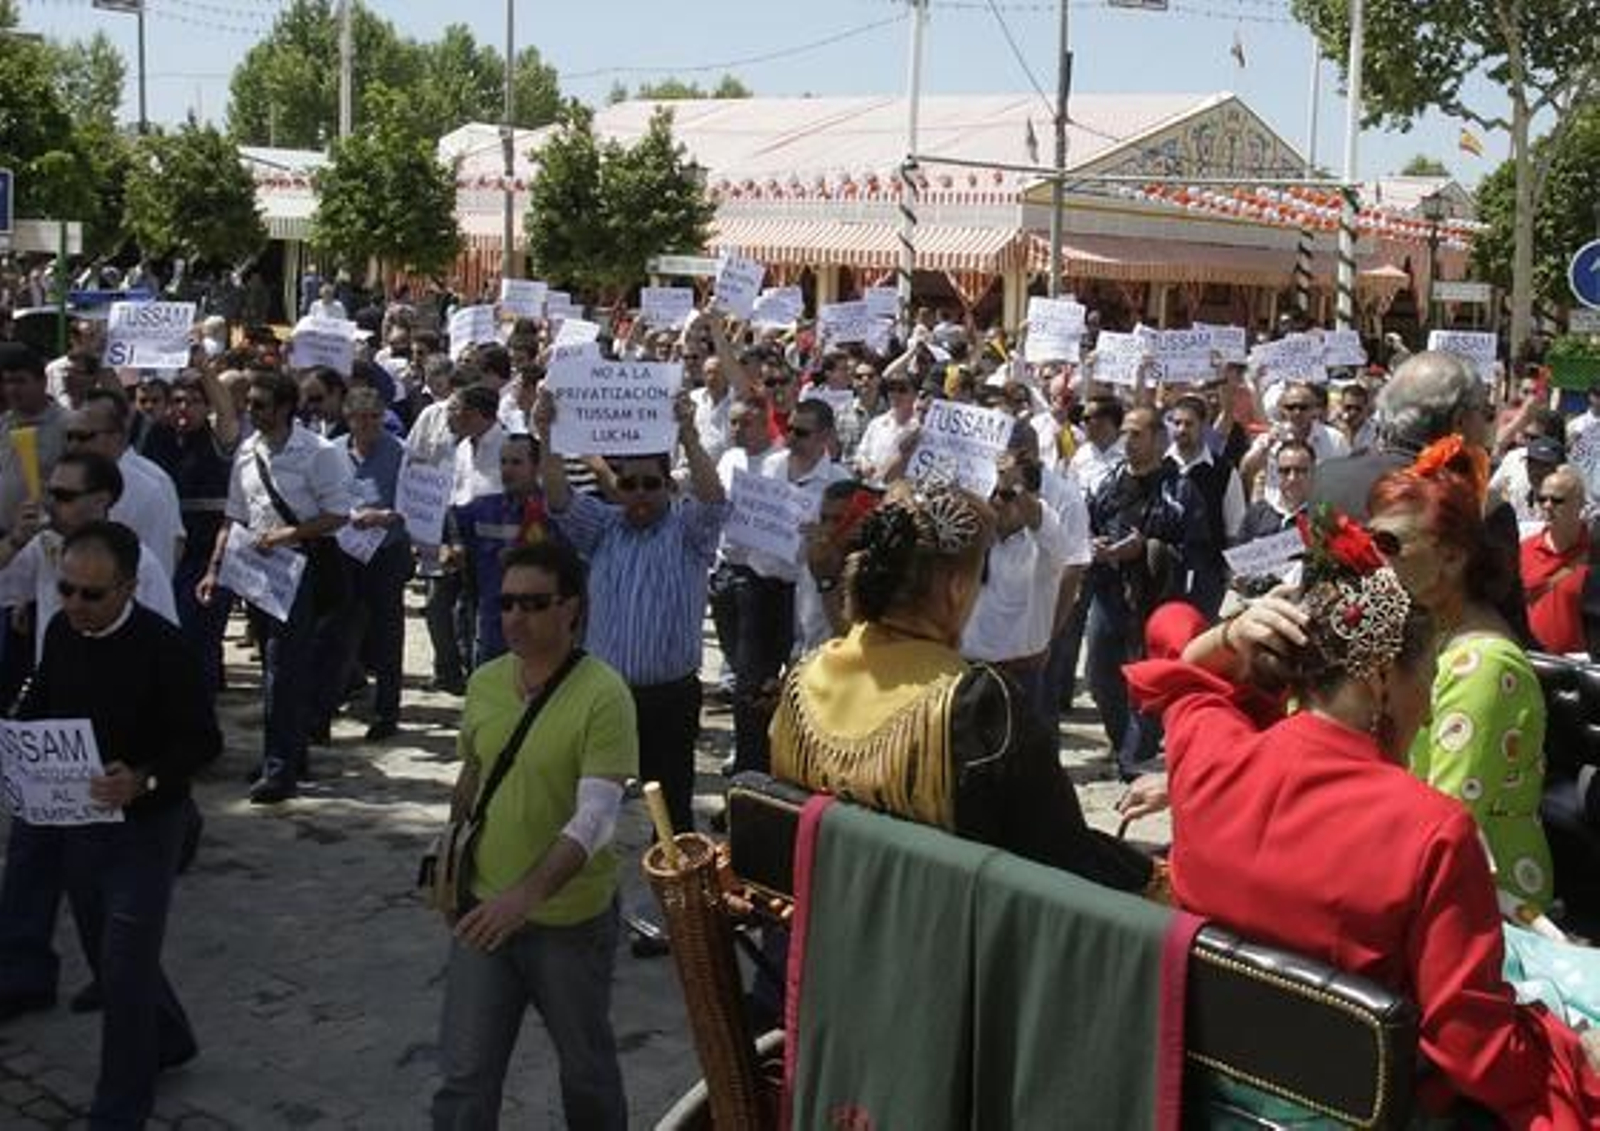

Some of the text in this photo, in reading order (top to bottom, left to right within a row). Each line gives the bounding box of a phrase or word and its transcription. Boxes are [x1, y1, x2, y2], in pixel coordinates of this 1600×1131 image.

[118, 306, 189, 328] TUSSAM
[1149, 332, 1211, 350] TUSSAM
[108, 341, 134, 365] SI
[591, 367, 652, 380] NO A LA
[555, 384, 669, 400] PRIVATIZACIÓN
[576, 407, 658, 420] TUSSAM EN
[929, 404, 1007, 442] TUSSAM
[592, 429, 640, 442] LUCHA
[51, 788, 77, 802] AL
